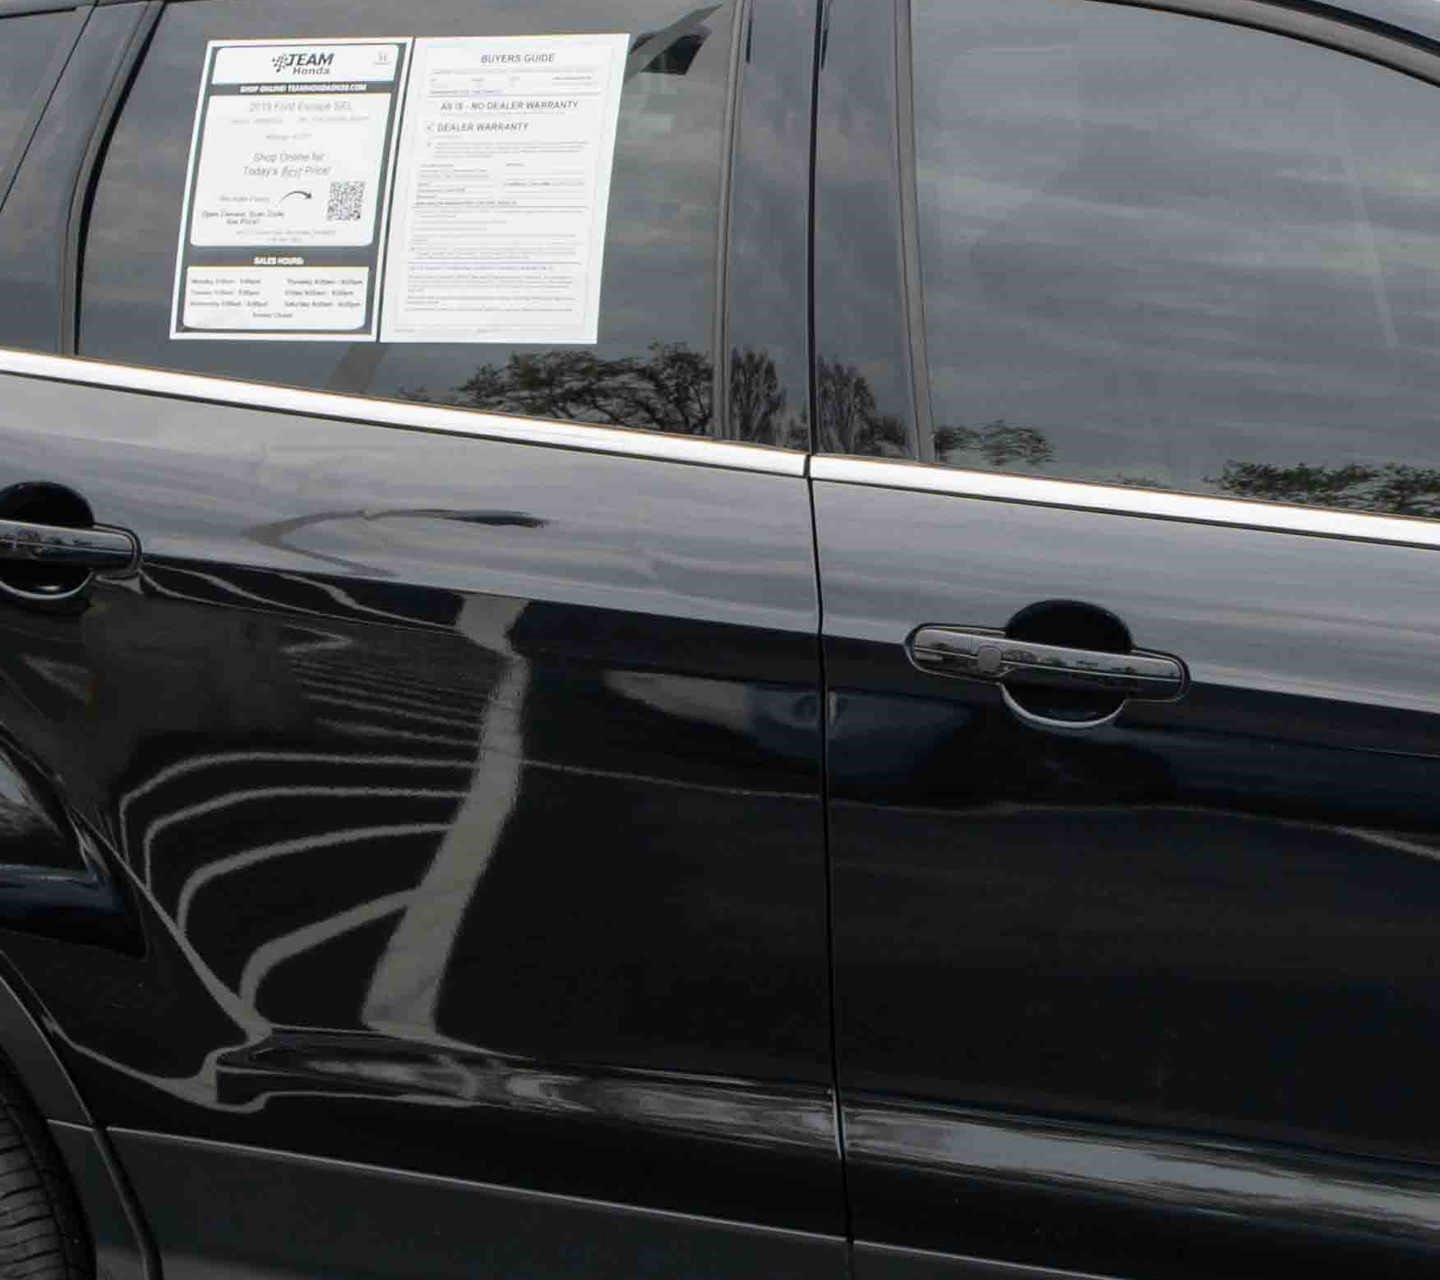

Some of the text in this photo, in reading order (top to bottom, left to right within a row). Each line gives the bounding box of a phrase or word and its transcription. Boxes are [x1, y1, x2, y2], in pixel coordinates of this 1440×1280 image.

[286, 52, 336, 67] TEAM
[480, 52, 556, 65] BUYERS GUIDE
[292, 66, 331, 76] Honda
[471, 102, 485, 111] NO
[486, 101, 524, 111] DEALER
[525, 100, 579, 110] WARRANTY
[437, 122, 529, 133] DEALER WARRANTY
